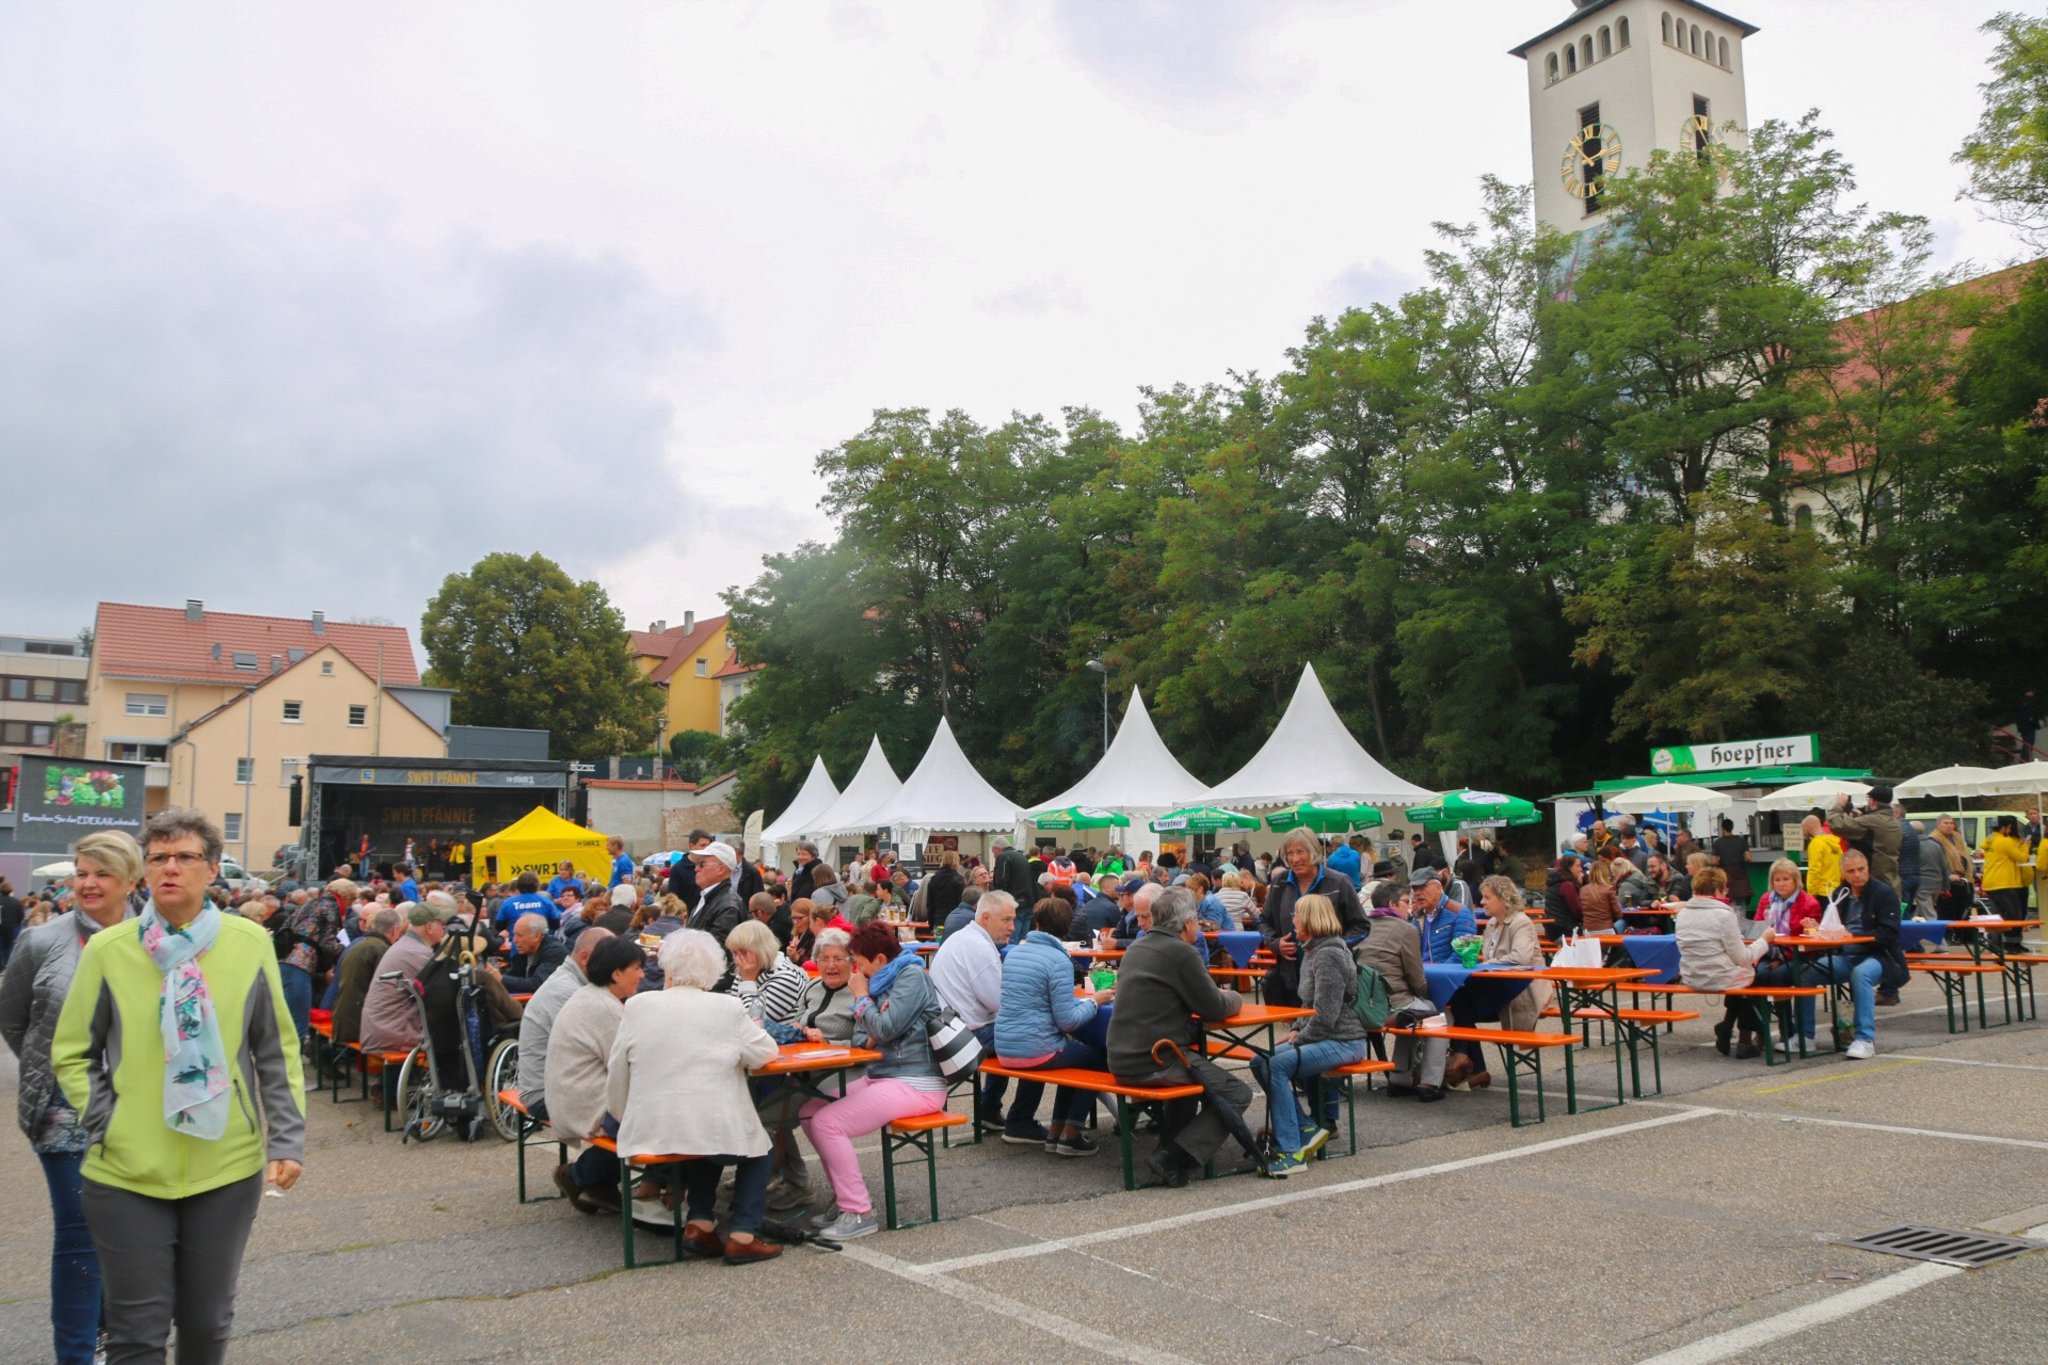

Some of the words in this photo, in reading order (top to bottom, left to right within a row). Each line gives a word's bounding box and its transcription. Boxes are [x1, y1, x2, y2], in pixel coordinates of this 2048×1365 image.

[1711, 742, 1795, 766] Hoepfner
[523, 863, 559, 875] SWR1
[513, 901, 541, 910] Team
